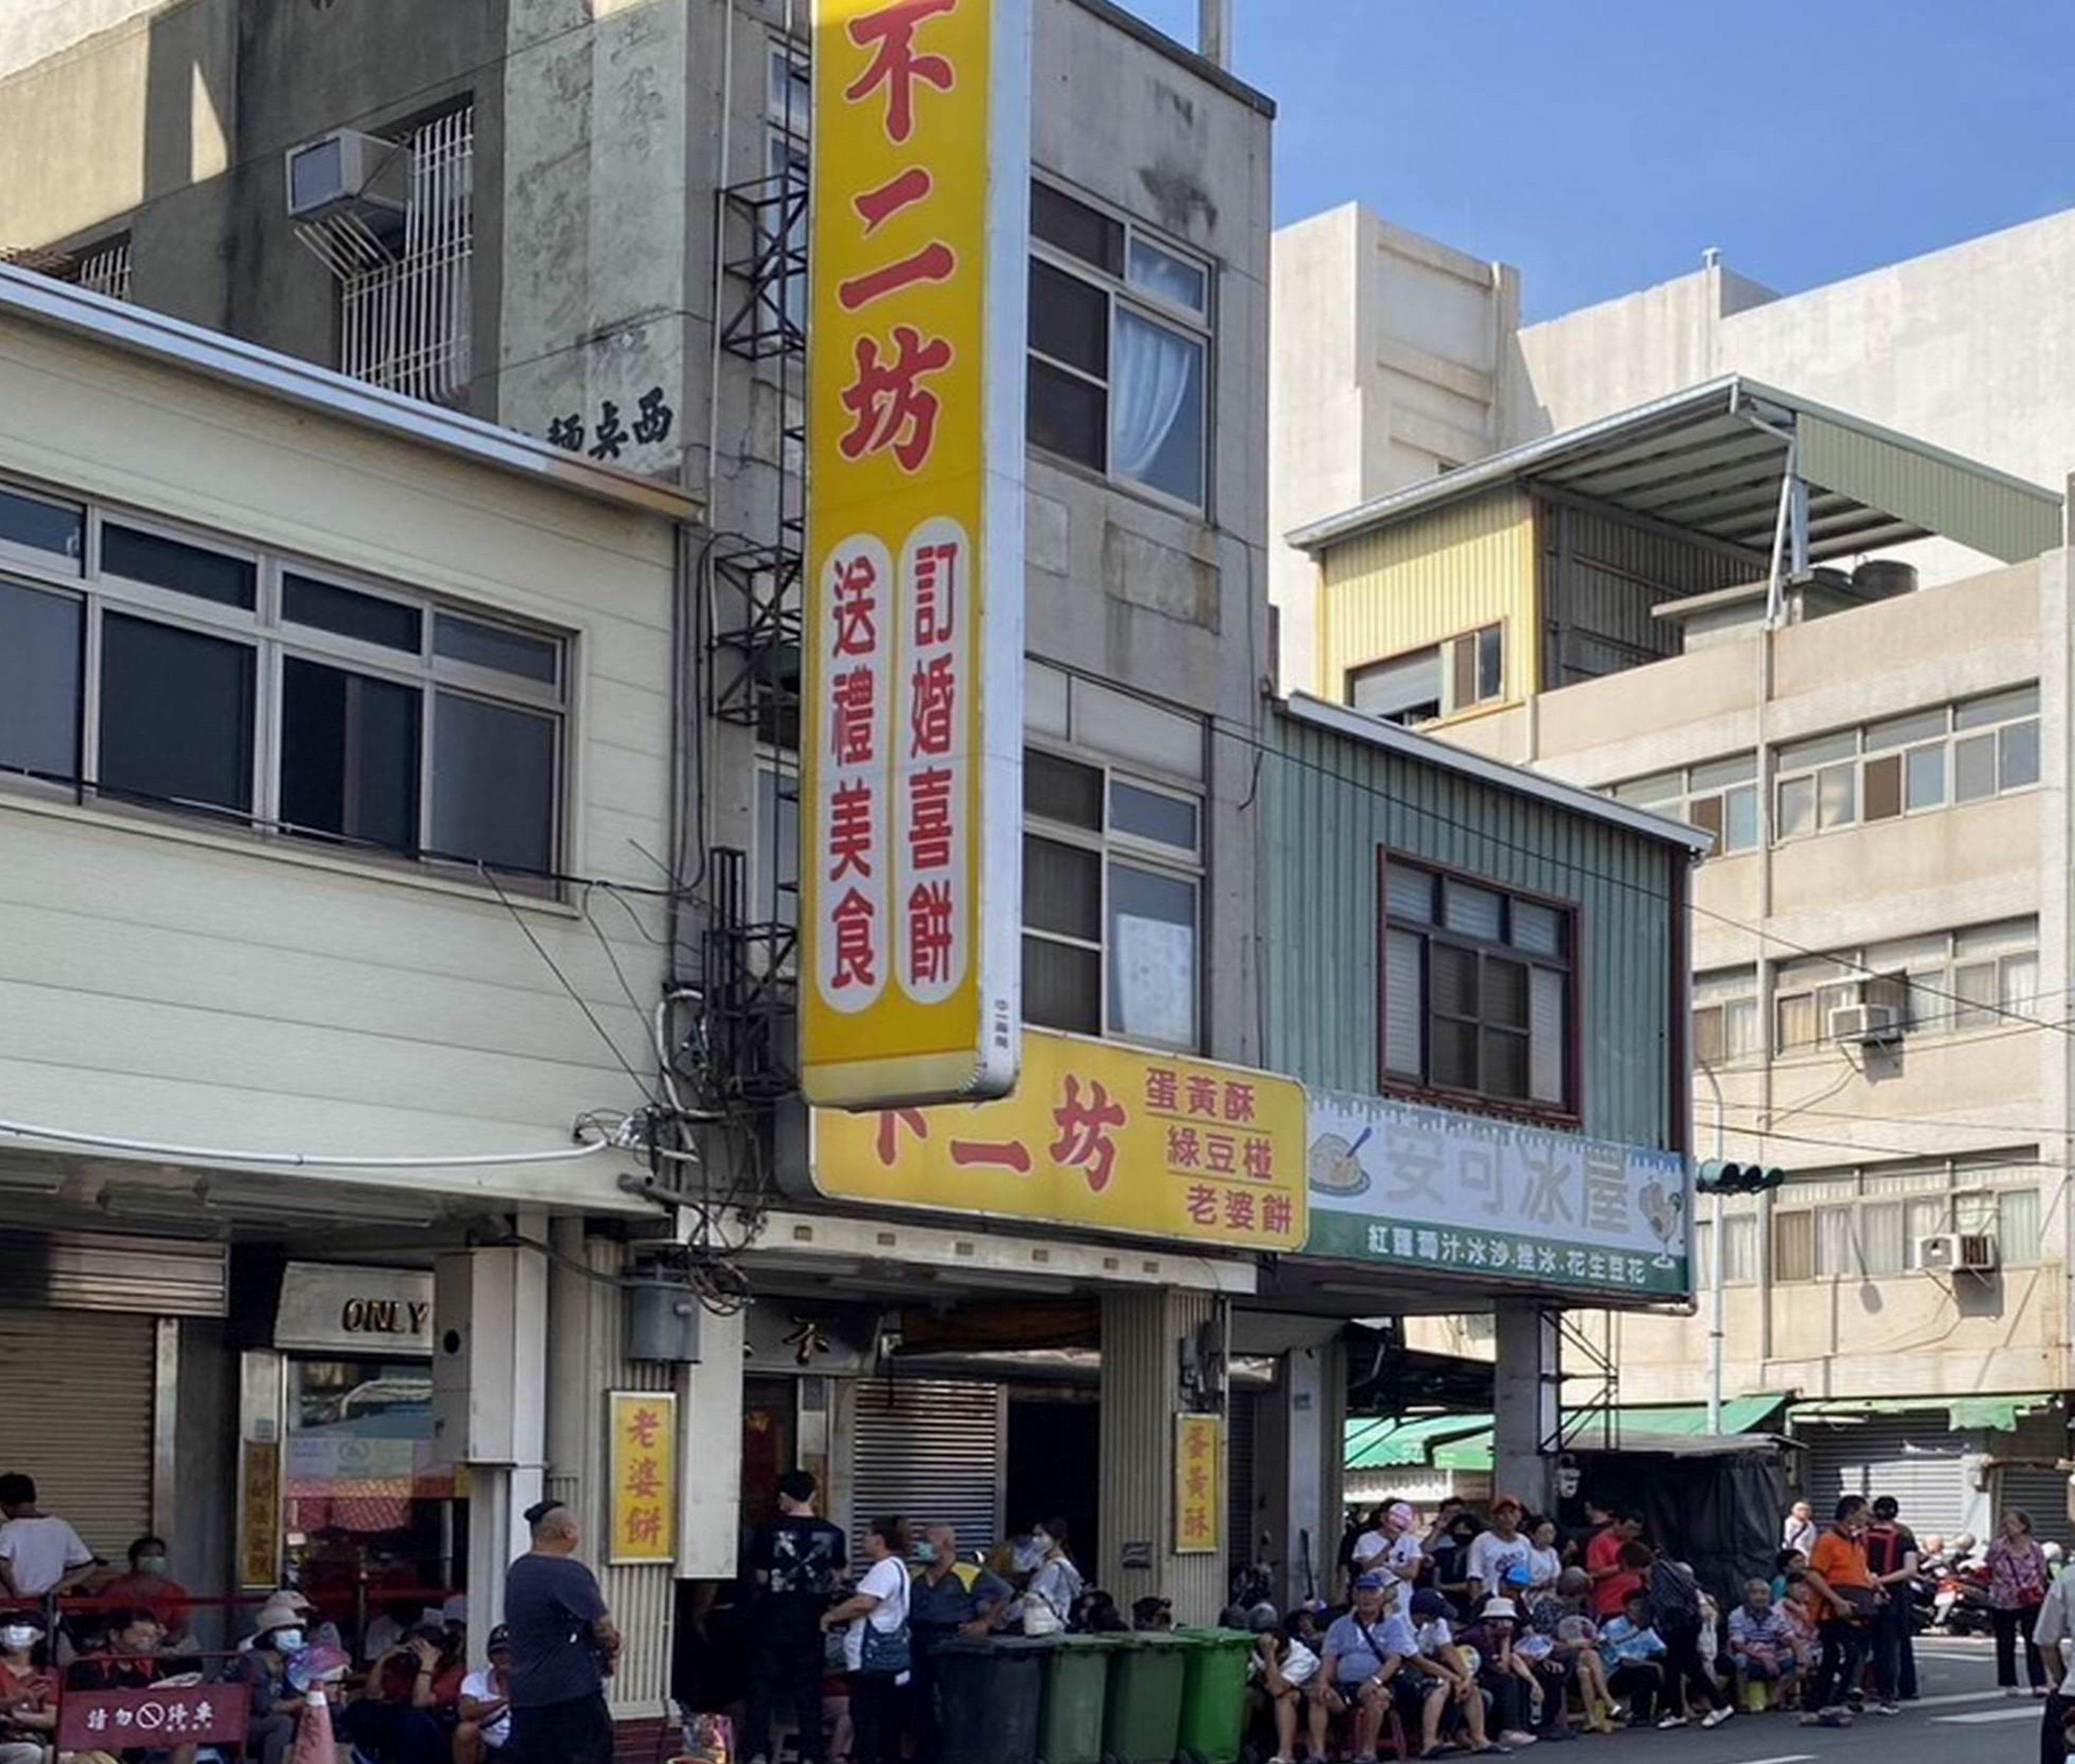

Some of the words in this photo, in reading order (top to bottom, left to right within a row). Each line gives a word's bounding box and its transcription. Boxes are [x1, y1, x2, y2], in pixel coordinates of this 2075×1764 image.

[838, 0, 957, 472] 不二坊
[830, 555, 877, 990] 送禮美食
[908, 542, 959, 985] 訂婚喜餅
[1145, 1067, 1255, 1122] 蛋黃酥
[1167, 1125, 1272, 1180] 綠豆椪
[1384, 1129, 1630, 1235] 安可冰屋
[1186, 1183, 1292, 1234] 老婆餅
[342, 1298, 430, 1334] ONLY
[625, 1408, 665, 1546] 老婆餅
